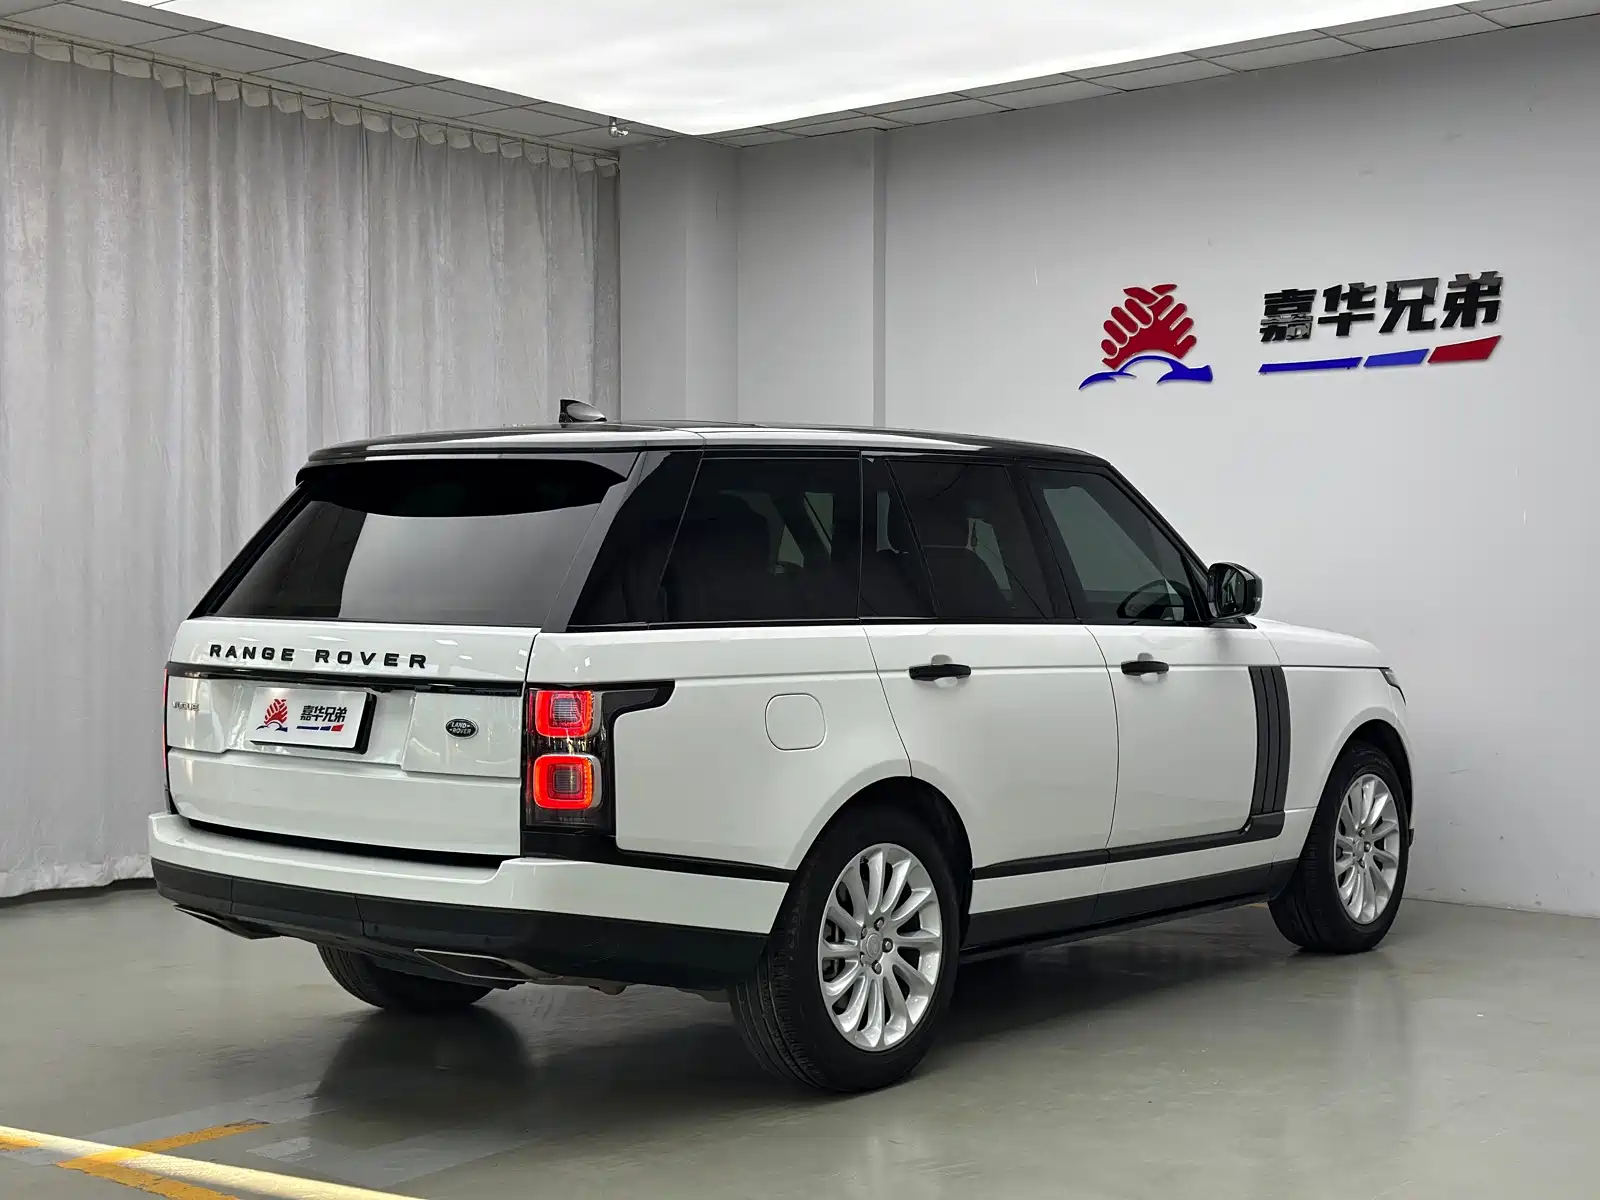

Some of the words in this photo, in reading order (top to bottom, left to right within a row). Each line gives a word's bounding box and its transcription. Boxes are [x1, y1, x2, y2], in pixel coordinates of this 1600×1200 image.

[1259, 271, 1503, 343] 嘉华兄弟
[209, 644, 295, 662] RANGE
[314, 649, 427, 669] ROVER
[300, 705, 347, 723] 嘉华兄弟
